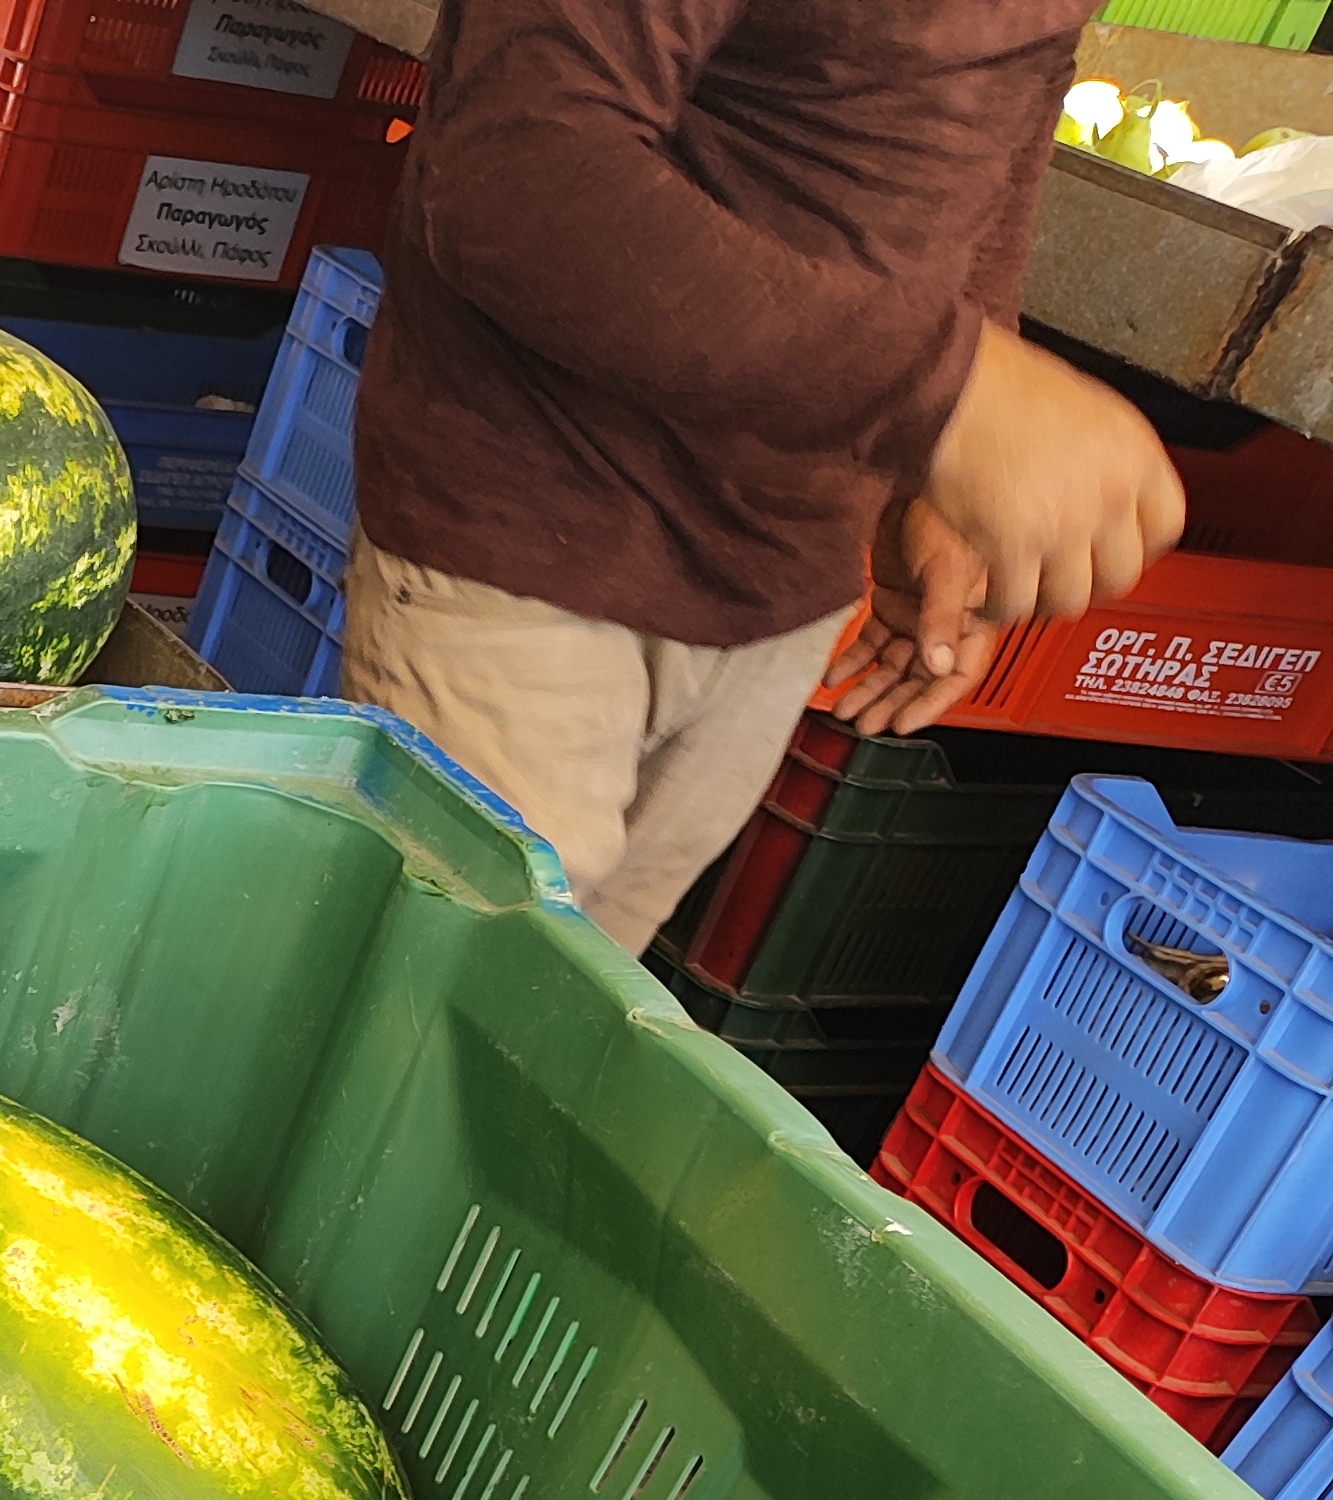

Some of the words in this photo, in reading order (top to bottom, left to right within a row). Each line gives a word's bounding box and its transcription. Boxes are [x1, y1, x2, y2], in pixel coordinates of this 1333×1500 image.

[157, 202, 269, 235] Παραγωγός
[1095, 628, 1157, 656] ΟΡΓ.
[1164, 636, 1193, 661] Π.
[1201, 640, 1321, 673] ΣΕΔΙΓΕΠ
[1080, 651, 1219, 688] ΣΩΤΗΡΑΣ
